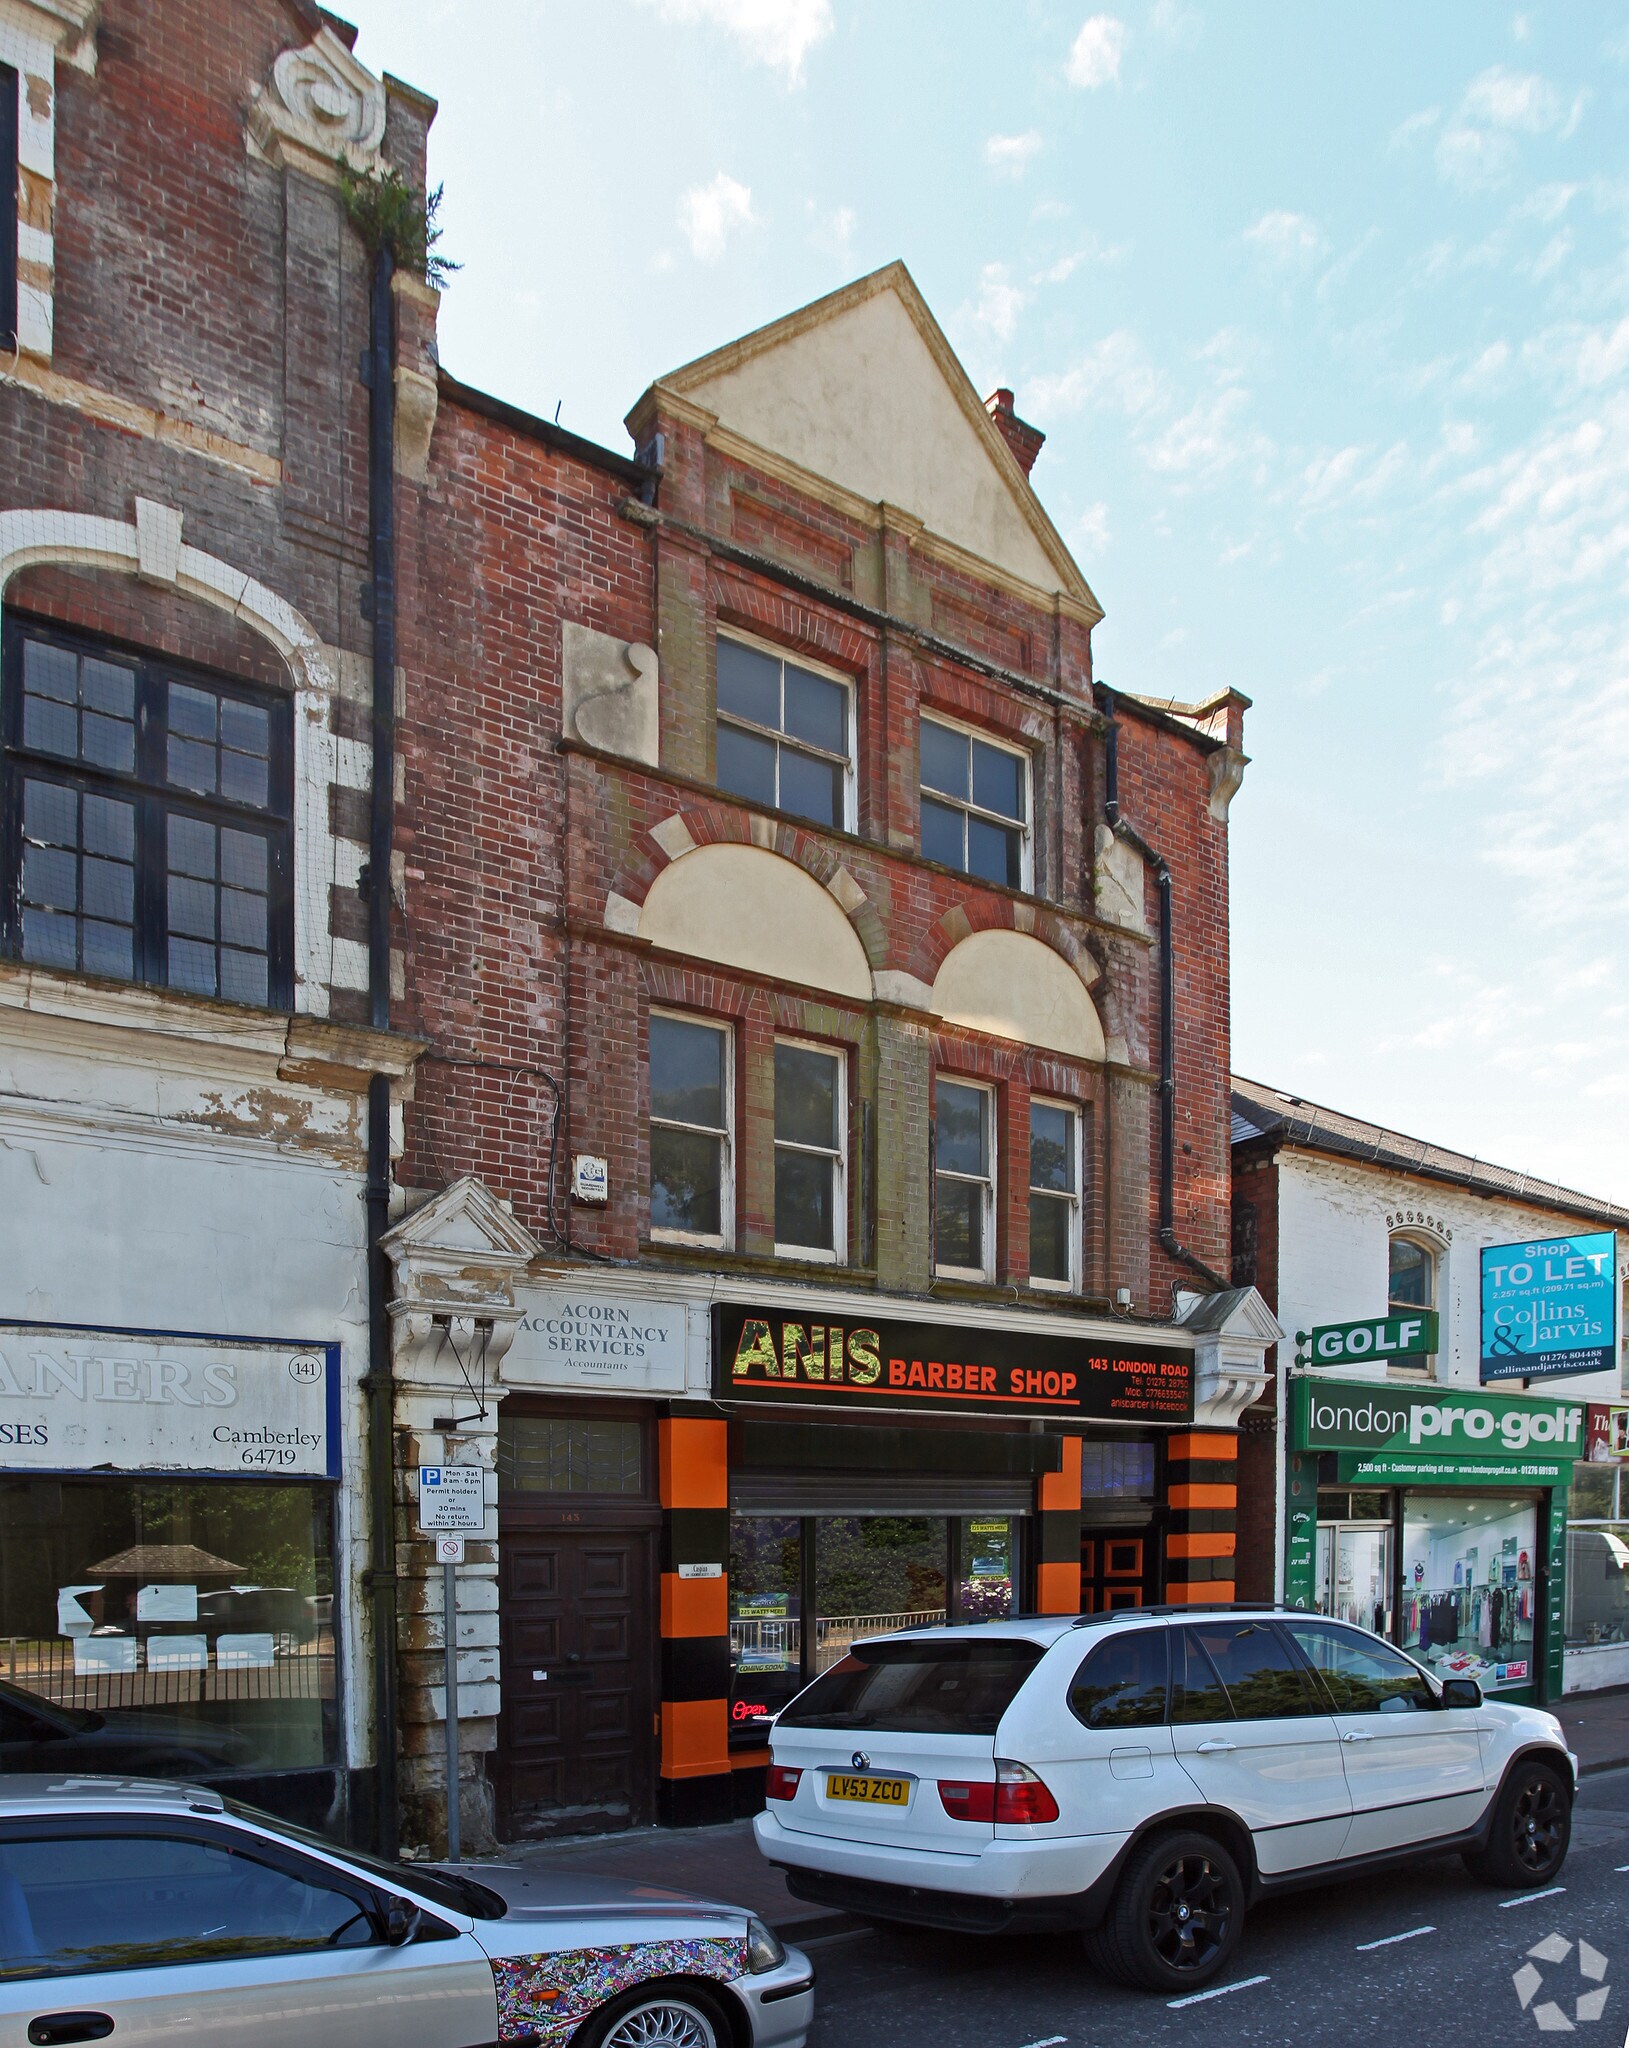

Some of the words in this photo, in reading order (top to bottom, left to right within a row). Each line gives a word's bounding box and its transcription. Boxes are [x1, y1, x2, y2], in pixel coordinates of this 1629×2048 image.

[1524, 1244, 1570, 1258] Shop
[1488, 1263, 1533, 1287] TO
[1545, 1252, 1609, 1282] LET
[1493, 1290, 1516, 1300] 2,257
[1519, 1286, 1540, 1298] sq.ft
[1542, 1283, 1574, 1295] (209.71
[1577, 1280, 1604, 1291] sq.m)
[561, 1304, 630, 1323] ACORN
[1493, 1300, 1585, 1327] Collins
[518, 1317, 669, 1342] ACCOUNTANCY
[1317, 1320, 1422, 1358] GOLF
[1489, 1325, 1527, 1358] &
[1527, 1317, 1602, 1348] Jarvis
[548, 1336, 645, 1356] SERVICES
[1540, 1353, 1567, 1362] 01276
[1569, 1350, 1602, 1360] 804488
[564, 1358, 629, 1370] Accountants
[731, 1319, 881, 1385] ANIS
[888, 1358, 997, 1392] BARBER
[1010, 1368, 1078, 1397] SHOP
[1088, 1358, 1108, 1371] 143
[1113, 1360, 1156, 1374] LONDON
[1160, 1363, 1189, 1377] ROAD
[1494, 1358, 1601, 1375] collinsandjarvis.co.uk
[294, 1362, 316, 1377] 141
[1310, 1397, 1407, 1434] london
[0, 1423, 48, 1446] SES
[213, 1425, 322, 1450] Camberley
[241, 1448, 297, 1466] 64719
[426, 1470, 438, 1484] P
[1391, 1463, 1417, 1472] Customer
[1417, 1464, 1437, 1474] parking
[1438, 1464, 1444, 1472] at
[1444, 1465, 1455, 1473] rear
[562, 1513, 580, 1521] 143
[739, 1665, 765, 1673] COMING
[732, 1700, 768, 1720] Open
[832, 1778, 868, 1798] LV53
[871, 1781, 902, 1800] ZCO
